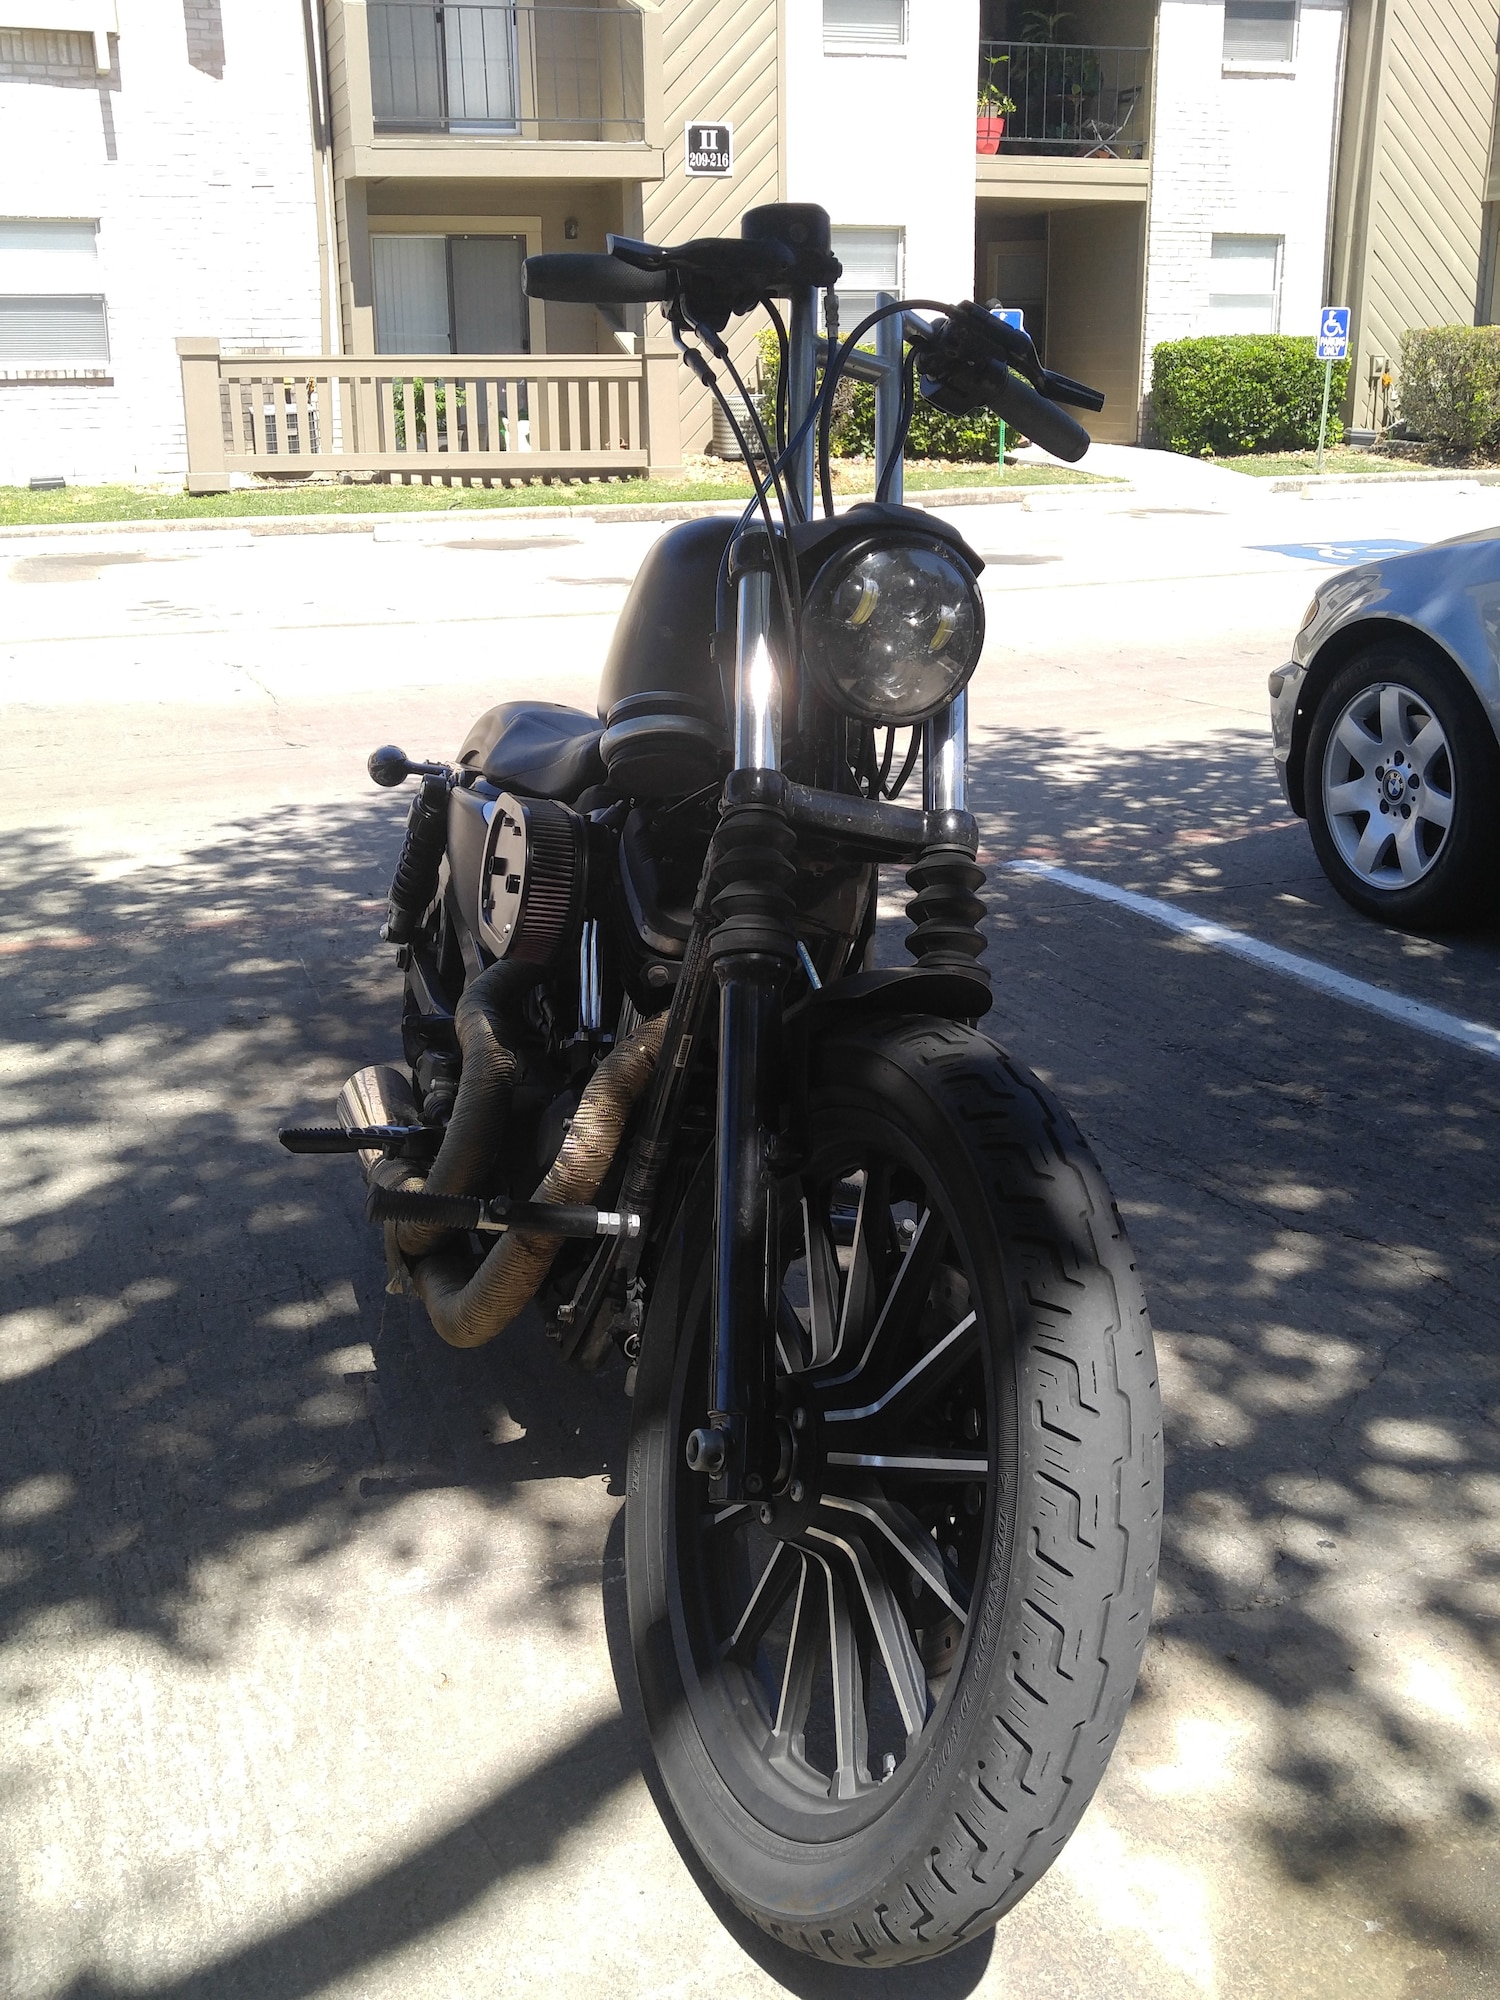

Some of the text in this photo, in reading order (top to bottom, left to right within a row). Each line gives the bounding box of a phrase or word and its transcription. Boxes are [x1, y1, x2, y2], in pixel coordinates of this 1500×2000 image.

[689, 152, 729, 167] 209-216
[1320, 336, 1346, 347] PARKING
[1323, 345, 1341, 356] ONLY
[973, 1511, 1008, 1681] DUNLOP
